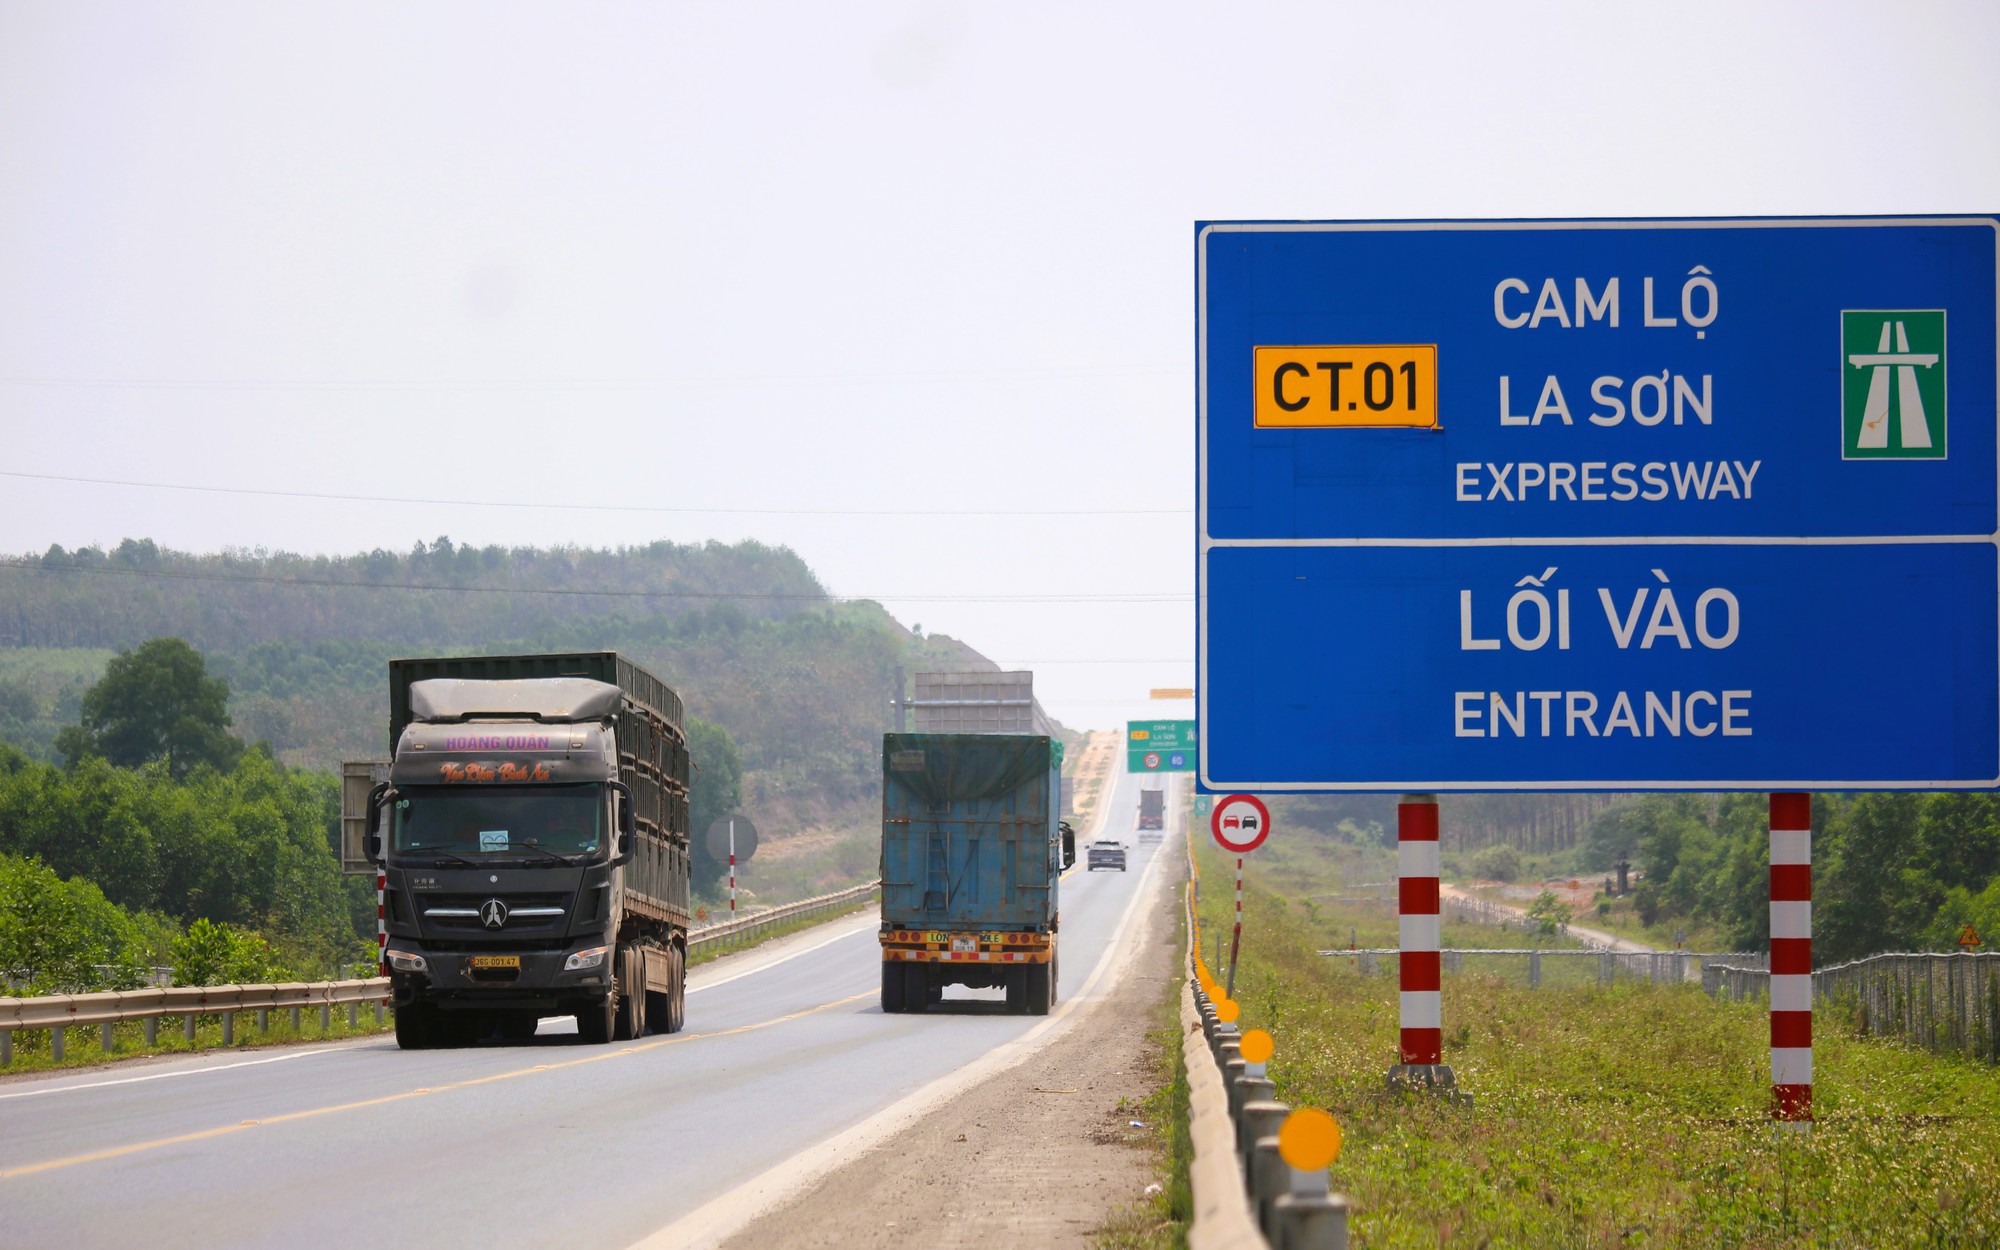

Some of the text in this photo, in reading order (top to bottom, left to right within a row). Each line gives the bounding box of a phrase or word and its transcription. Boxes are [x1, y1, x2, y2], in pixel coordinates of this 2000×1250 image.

[1494, 265, 1719, 340] CAM LỘ
[1274, 361, 1416, 412] CT.01
[1499, 368, 1713, 427] LA SƠN
[1456, 460, 1761, 502] EXPRESSWAY
[1460, 566, 1740, 651] LỐI VÀO
[1454, 690, 1753, 738] ENTRANCE
[930, 933, 949, 942] LON
